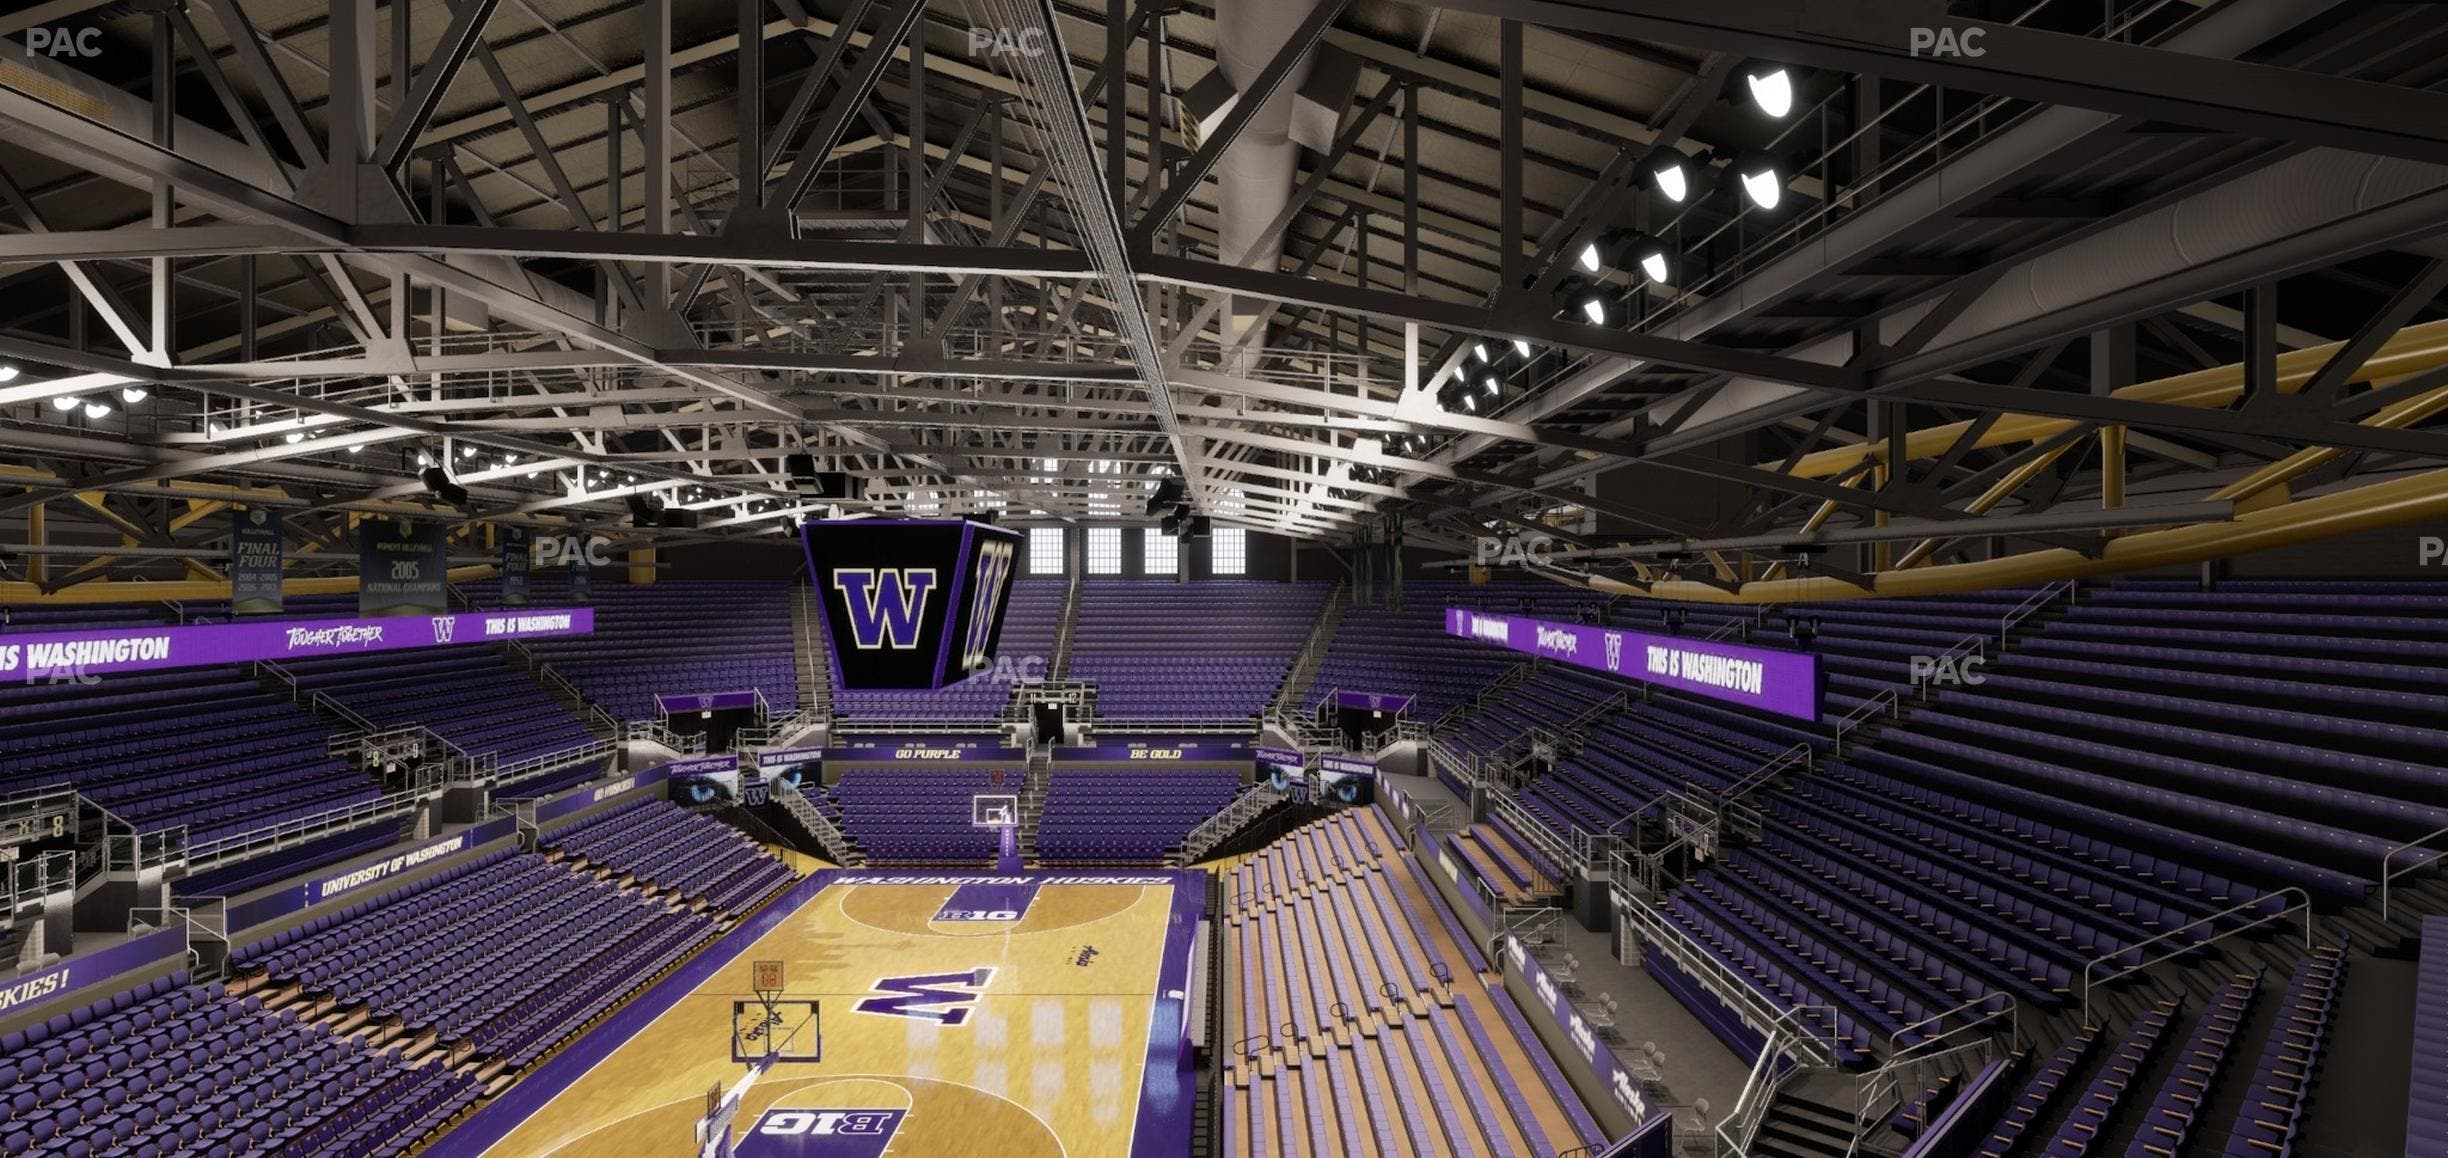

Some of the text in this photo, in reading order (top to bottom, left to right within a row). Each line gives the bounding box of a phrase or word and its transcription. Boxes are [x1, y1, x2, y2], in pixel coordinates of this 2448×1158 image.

[237, 543, 279, 554] FINAL
[239, 555, 278, 567] FOUR
[391, 561, 419, 579] 2005
[833, 568, 937, 650] W
[486, 615, 571, 634] THIS IS WASHINGTON
[27, 637, 170, 669] WASHINGTON
[1647, 646, 1763, 695] THIS IS WASHINGTON
[896, 749, 961, 759] GO PURPLE
[1130, 749, 1182, 759] BE GOLD
[52, 815, 64, 837] 8
[322, 836, 463, 897] UNIVERSITY OF WASHINGTON
[834, 877, 1173, 885] WASHINGTON HUSKIES
[0, 968, 70, 1010] KIES!
